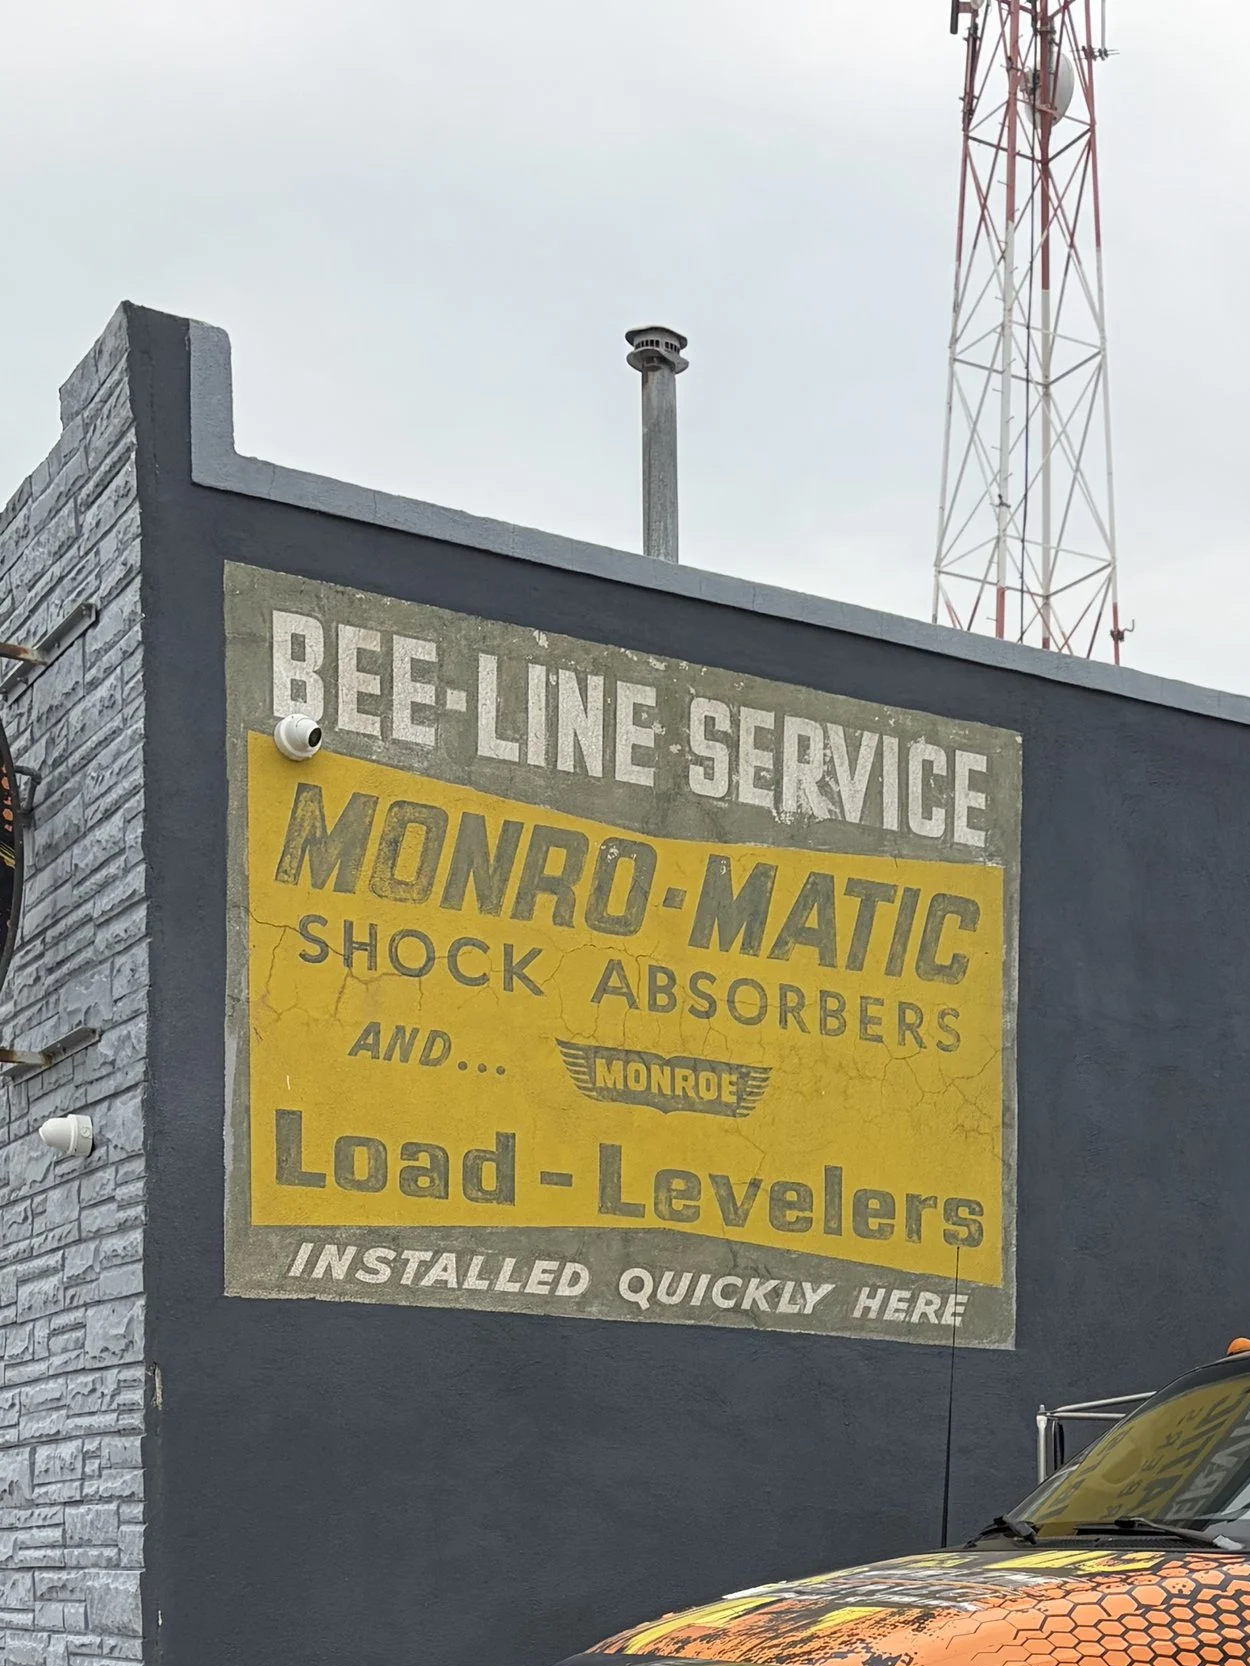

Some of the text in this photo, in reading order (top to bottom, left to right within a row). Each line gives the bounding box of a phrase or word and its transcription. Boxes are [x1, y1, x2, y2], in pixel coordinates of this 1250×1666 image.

[270, 609, 990, 847] BEE-LINE SERVICE
[274, 783, 982, 985] MONRO-MATIC
[299, 914, 962, 1054] SHOCK ABSORBERS
[595, 1061, 741, 1104] MONROE
[274, 1108, 517, 1206] Load
[597, 1142, 986, 1249] Levelers
[288, 1242, 969, 1328] INSTALLED QUICKLY HERE
